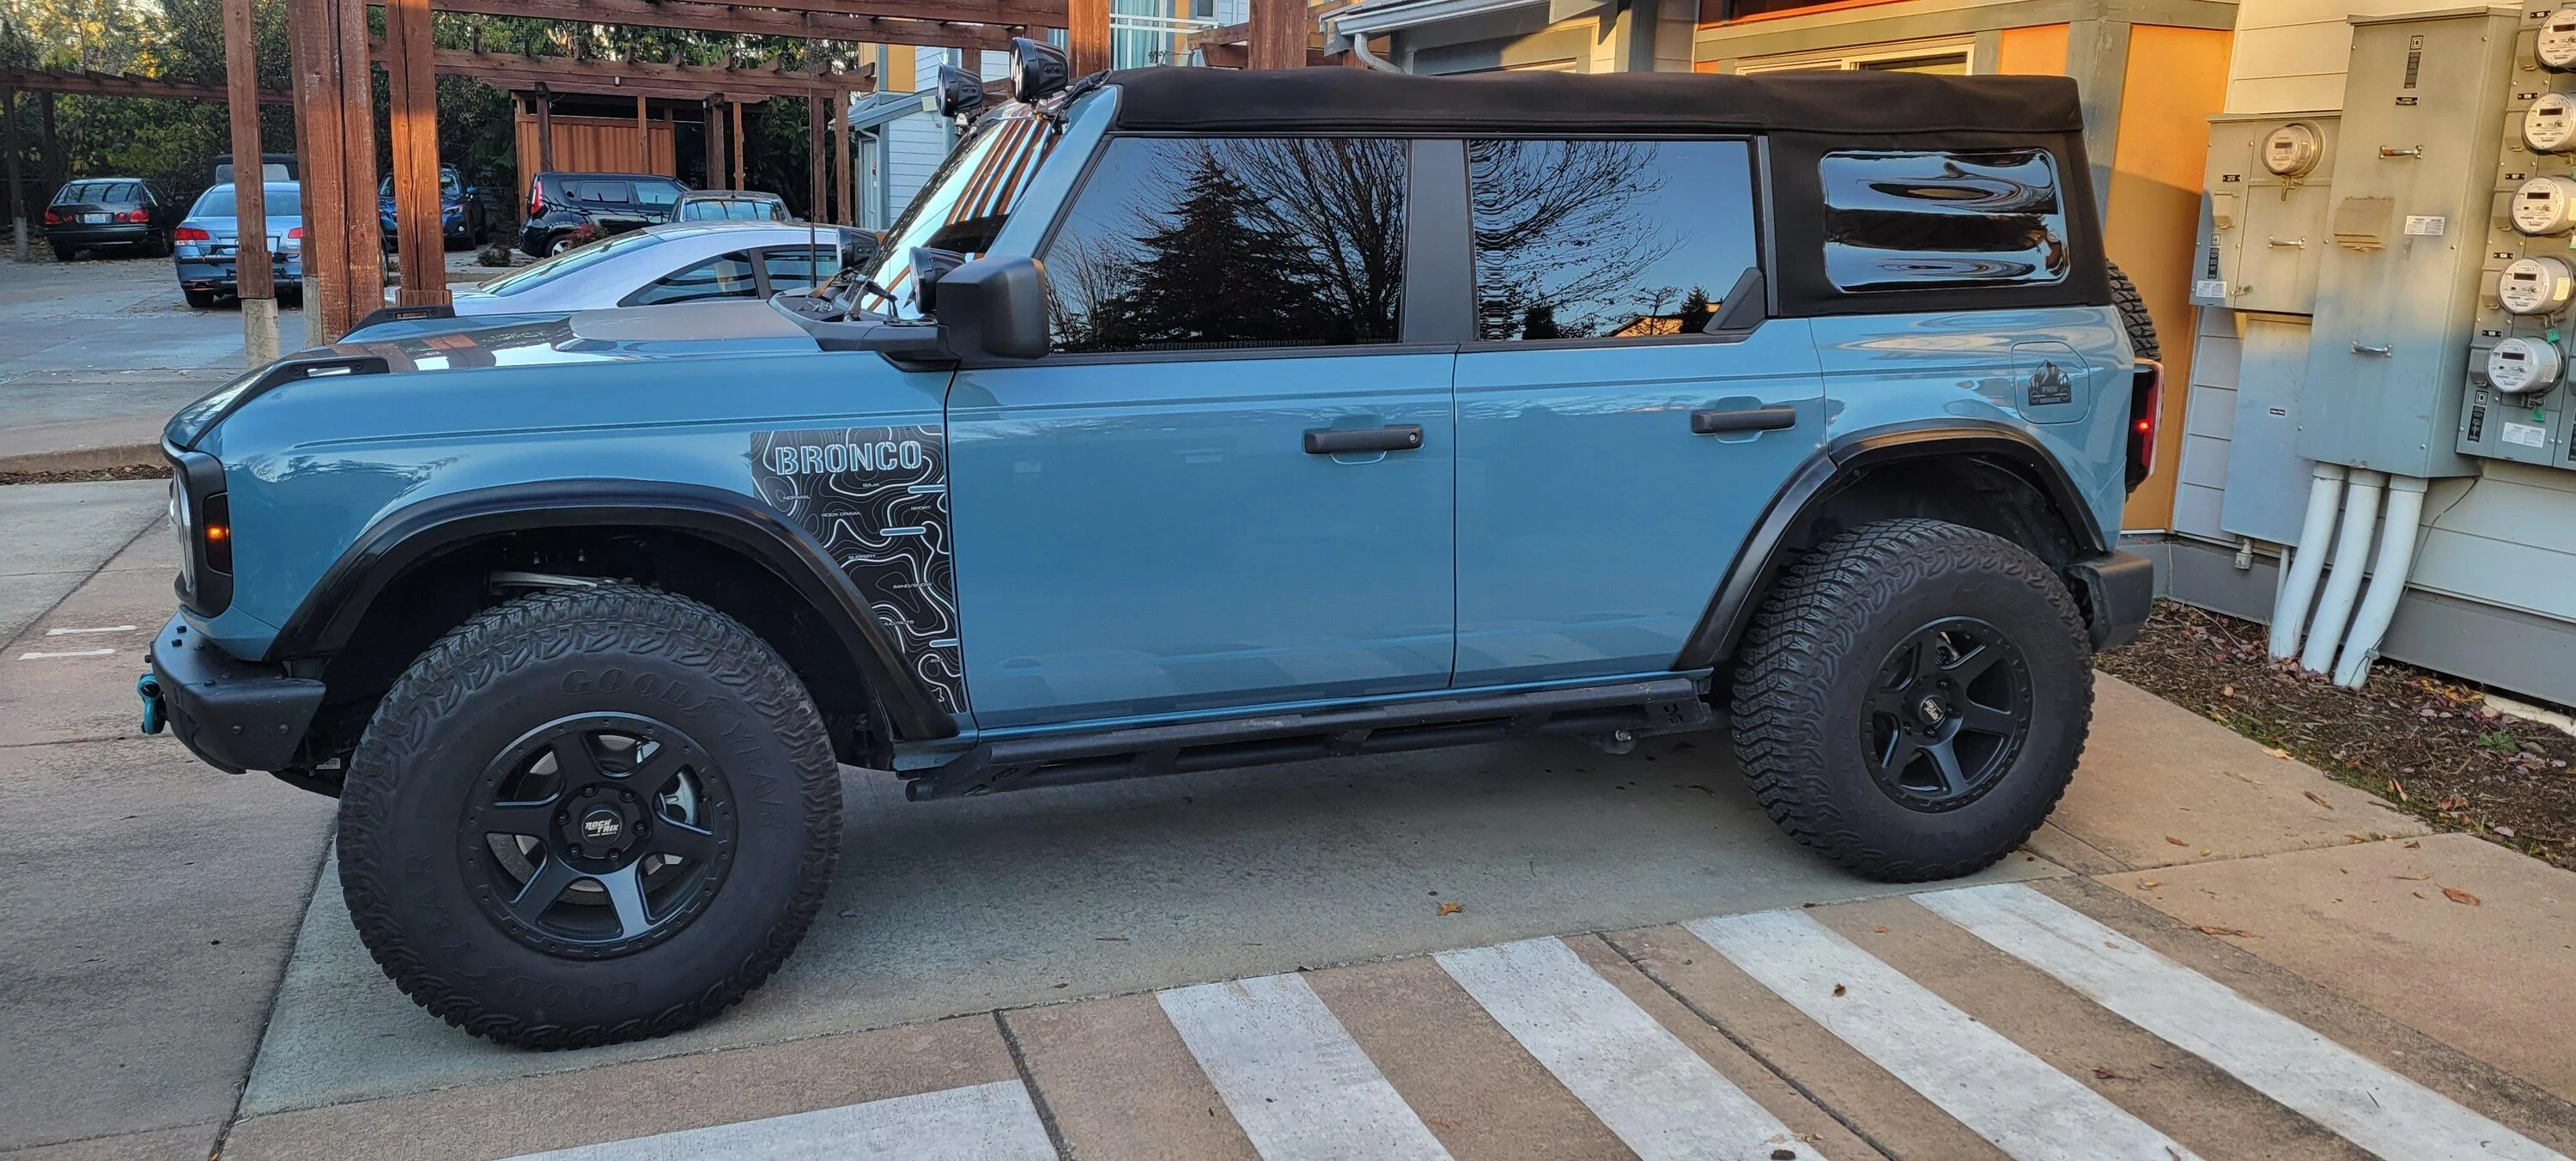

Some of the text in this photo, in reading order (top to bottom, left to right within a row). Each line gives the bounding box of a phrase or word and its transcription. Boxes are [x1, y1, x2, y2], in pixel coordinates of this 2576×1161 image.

[775, 441, 922, 476] BRONCO
[585, 818, 611, 830] ROCK
[597, 824, 619, 833] TRIX
